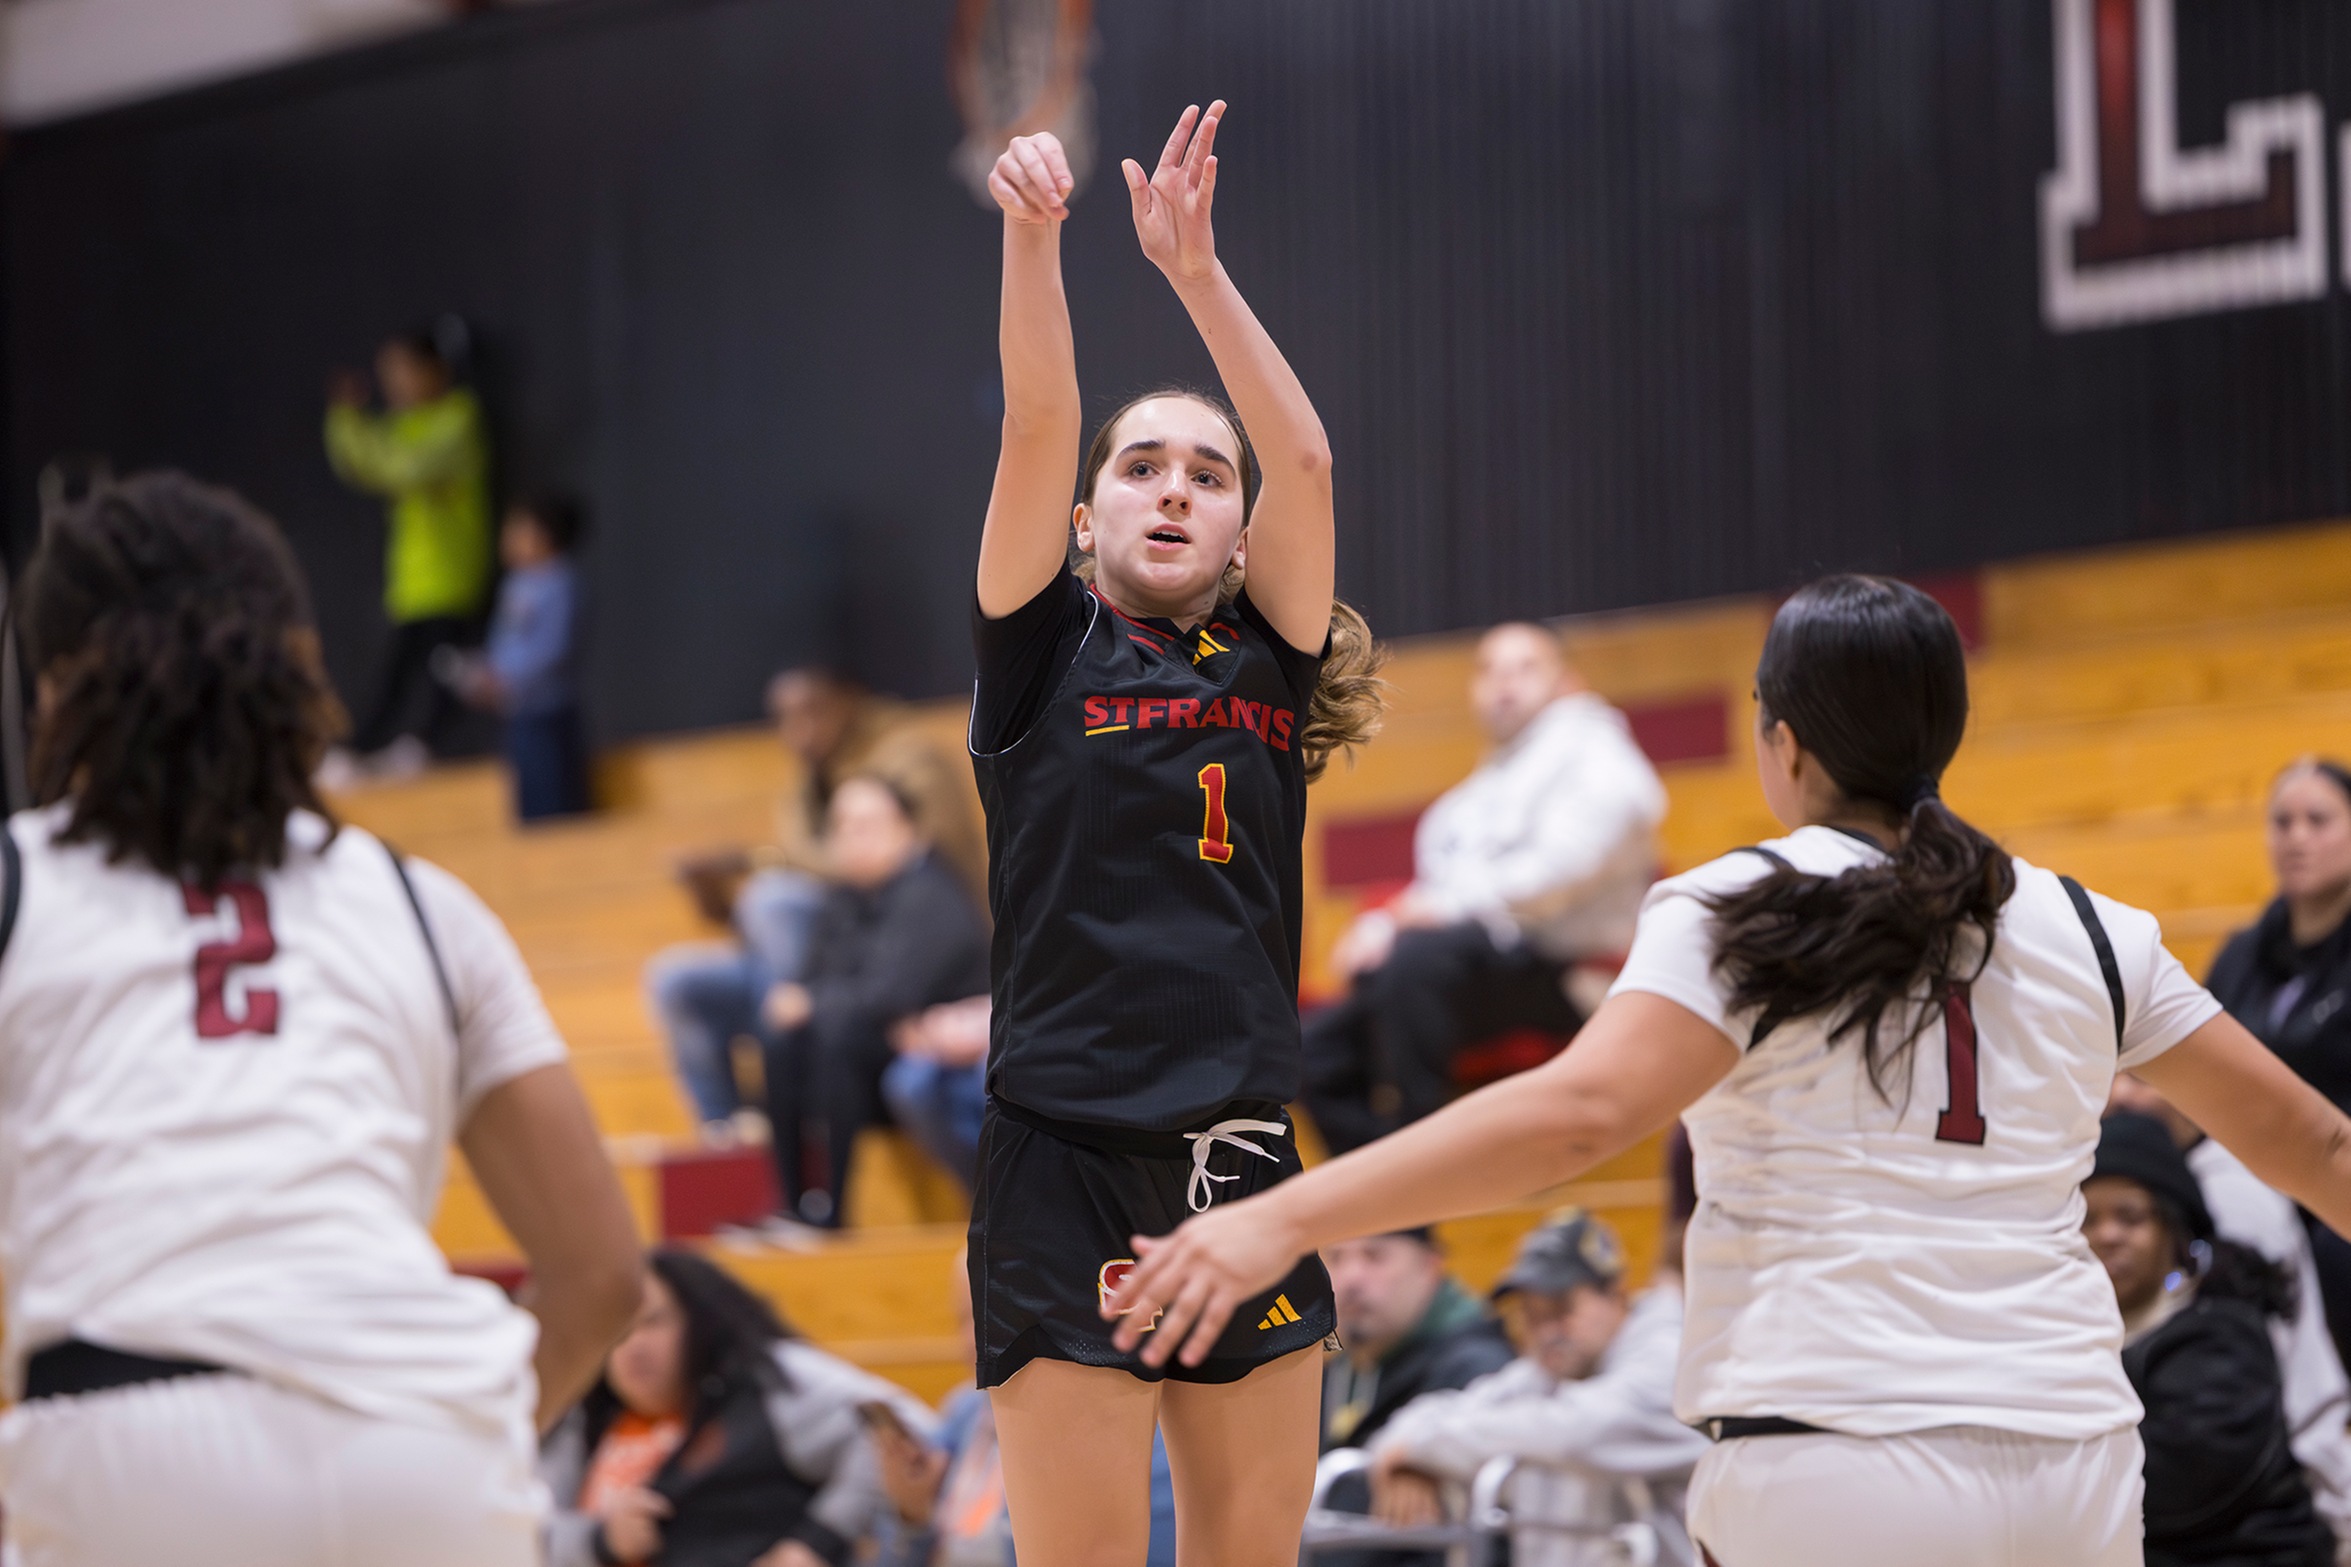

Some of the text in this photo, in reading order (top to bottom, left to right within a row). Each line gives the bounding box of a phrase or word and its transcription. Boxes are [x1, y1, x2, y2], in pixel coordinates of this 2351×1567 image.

[2037, 0, 2351, 333] L
[1198, 762, 1234, 864] 1
[182, 874, 279, 1039] 2
[1932, 978, 1986, 1147] 1
